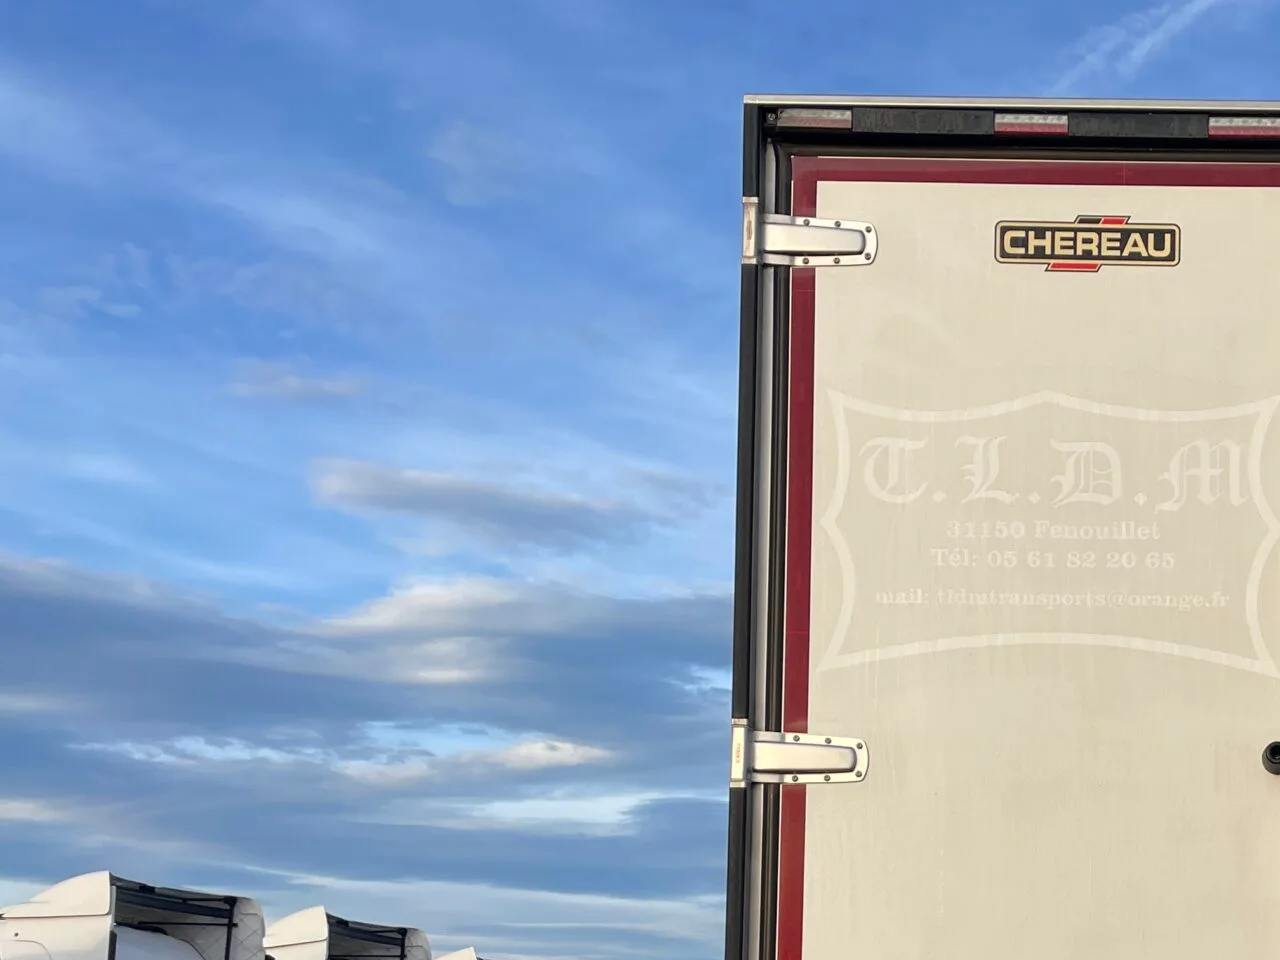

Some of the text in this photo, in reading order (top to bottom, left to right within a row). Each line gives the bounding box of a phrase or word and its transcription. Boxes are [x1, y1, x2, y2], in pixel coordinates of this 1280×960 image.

[1003, 230, 1171, 258] CHEREAU
[946, 520, 1161, 541] 31150 Fenouillet
[930, 547, 1176, 570] Tél: 05 61 82 20 65
[875, 588, 929, 606] mail:
